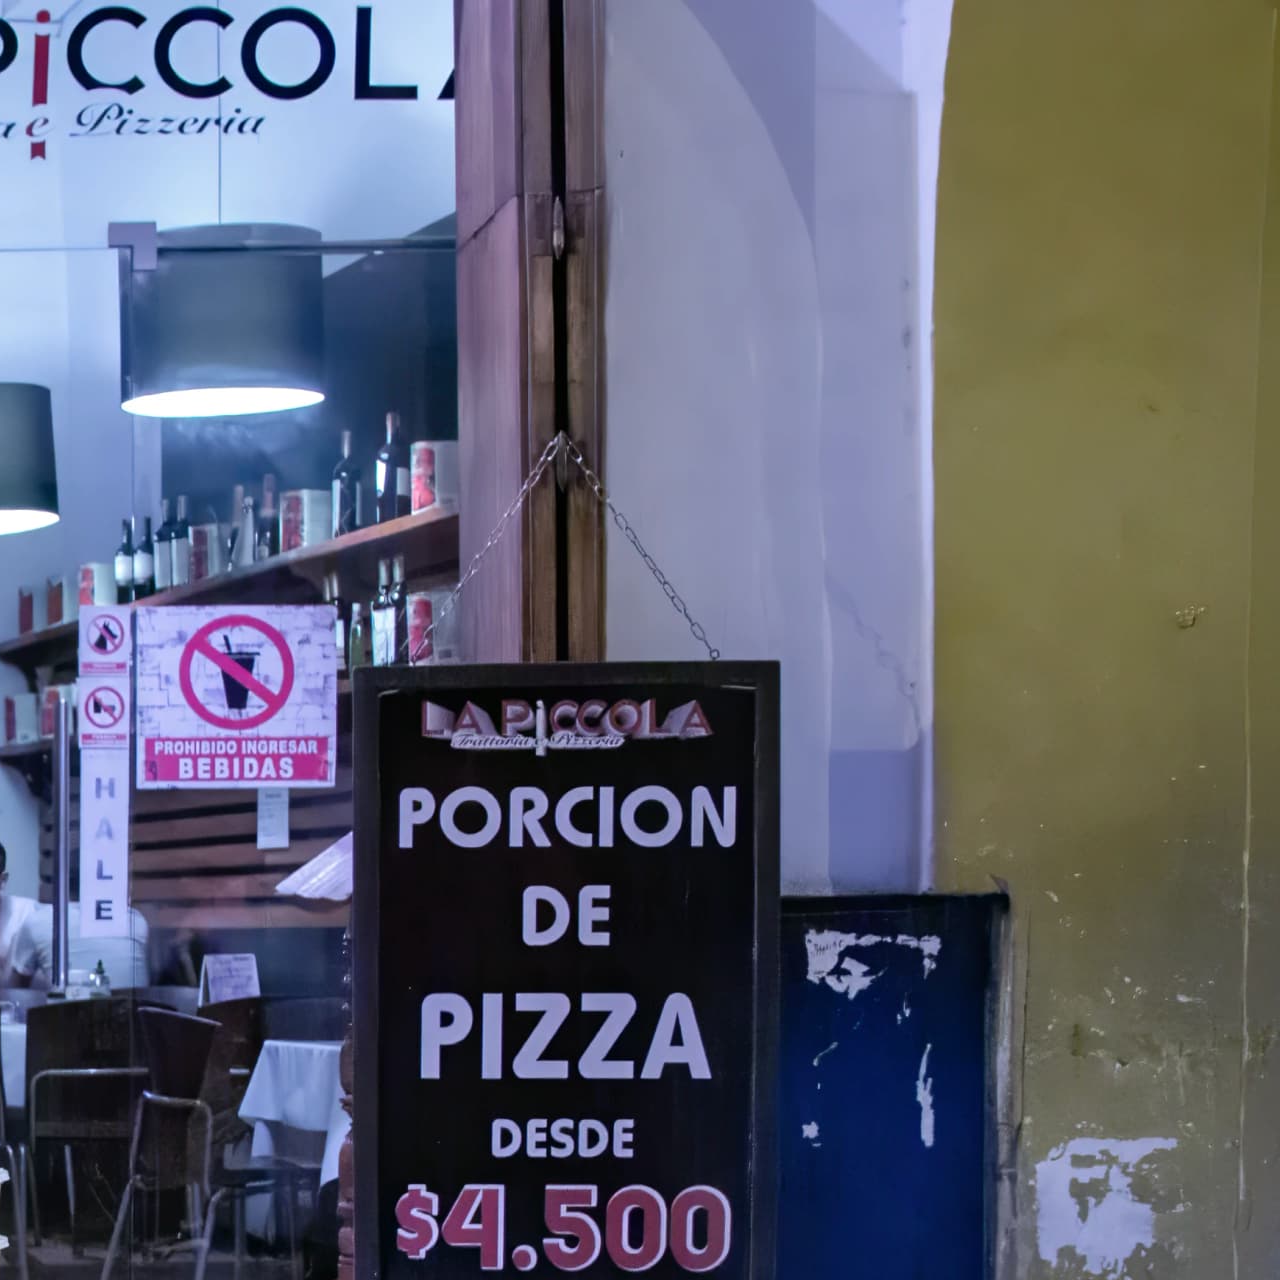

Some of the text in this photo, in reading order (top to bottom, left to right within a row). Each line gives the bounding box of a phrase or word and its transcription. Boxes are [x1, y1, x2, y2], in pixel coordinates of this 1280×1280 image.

[24, 115, 50, 138] e
[69, 101, 266, 137] Pizzeria
[421, 699, 482, 736] LA
[154, 739, 318, 755] PROHIBIDO INGRESAR
[178, 757, 294, 780] BEBIDAS
[398, 785, 737, 849] PORCION
[94, 776, 116, 918] HALE
[521, 884, 612, 947] DE
[419, 991, 711, 1080] PIZZA
[490, 1117, 635, 1159] DESDE
[395, 1182, 734, 1273] $4.500
